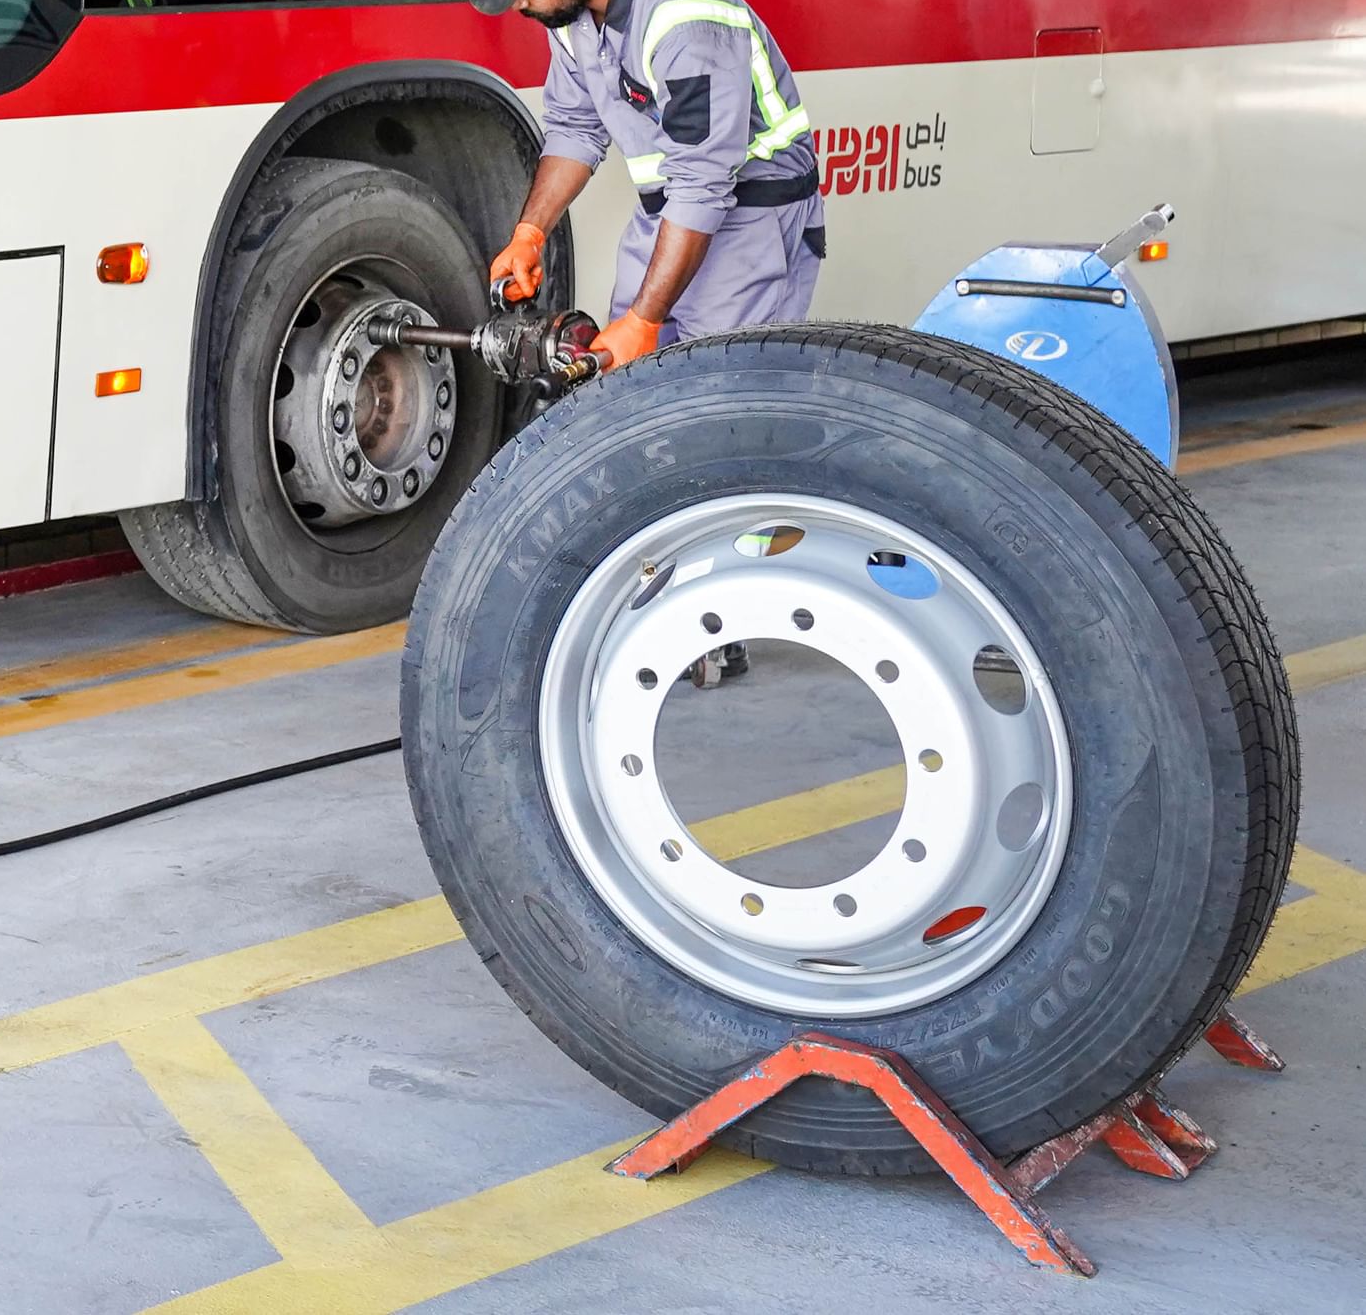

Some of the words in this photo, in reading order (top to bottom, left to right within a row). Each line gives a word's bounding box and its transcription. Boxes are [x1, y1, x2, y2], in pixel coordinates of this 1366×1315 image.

[905, 112, 946, 151] باص
[813, 123, 901, 197] UBAI
[903, 158, 942, 190] bus
[506, 464, 617, 582] KMAX
[643, 438, 677, 474] S
